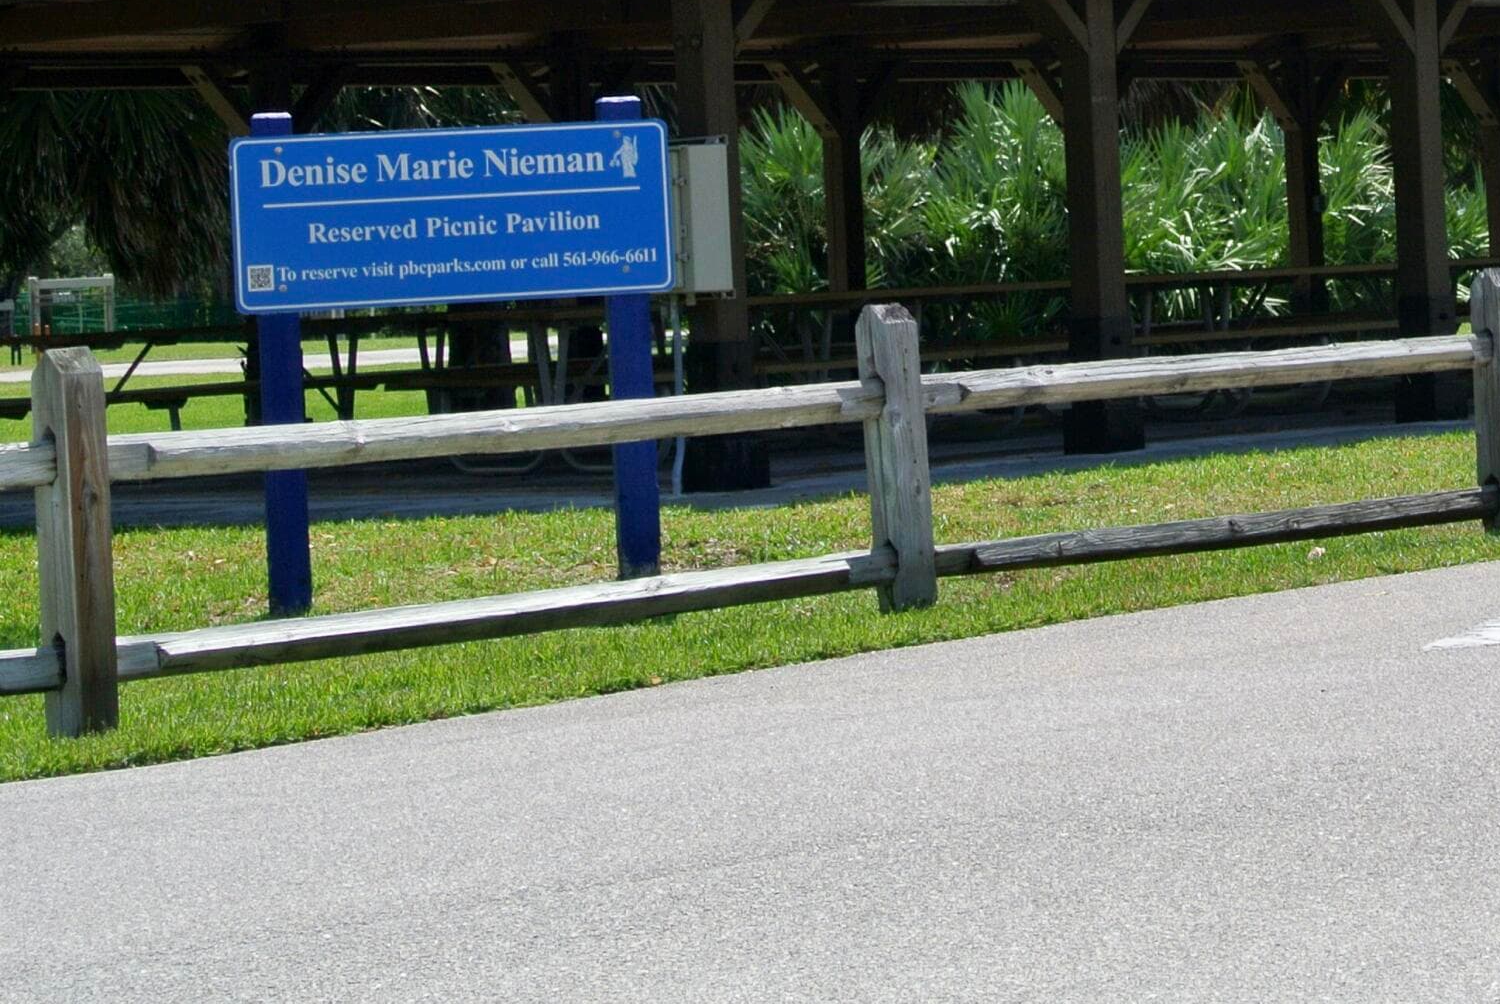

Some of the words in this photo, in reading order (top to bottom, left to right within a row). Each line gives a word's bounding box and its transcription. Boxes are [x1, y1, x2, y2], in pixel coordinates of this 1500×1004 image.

[259, 156, 368, 188] Denise
[376, 150, 474, 183] Marie
[482, 147, 605, 178] Nieman
[308, 218, 418, 244] Reserved
[426, 214, 498, 238] Picnic
[506, 210, 600, 234] Pavilion
[277, 266, 297, 282] To
[301, 268, 358, 281] reserve
[362, 261, 394, 277] visit
[399, 256, 506, 280] pbcparks.com
[511, 258, 527, 270] or
[531, 252, 559, 269] call
[563, 247, 658, 267] 561-966-6611
